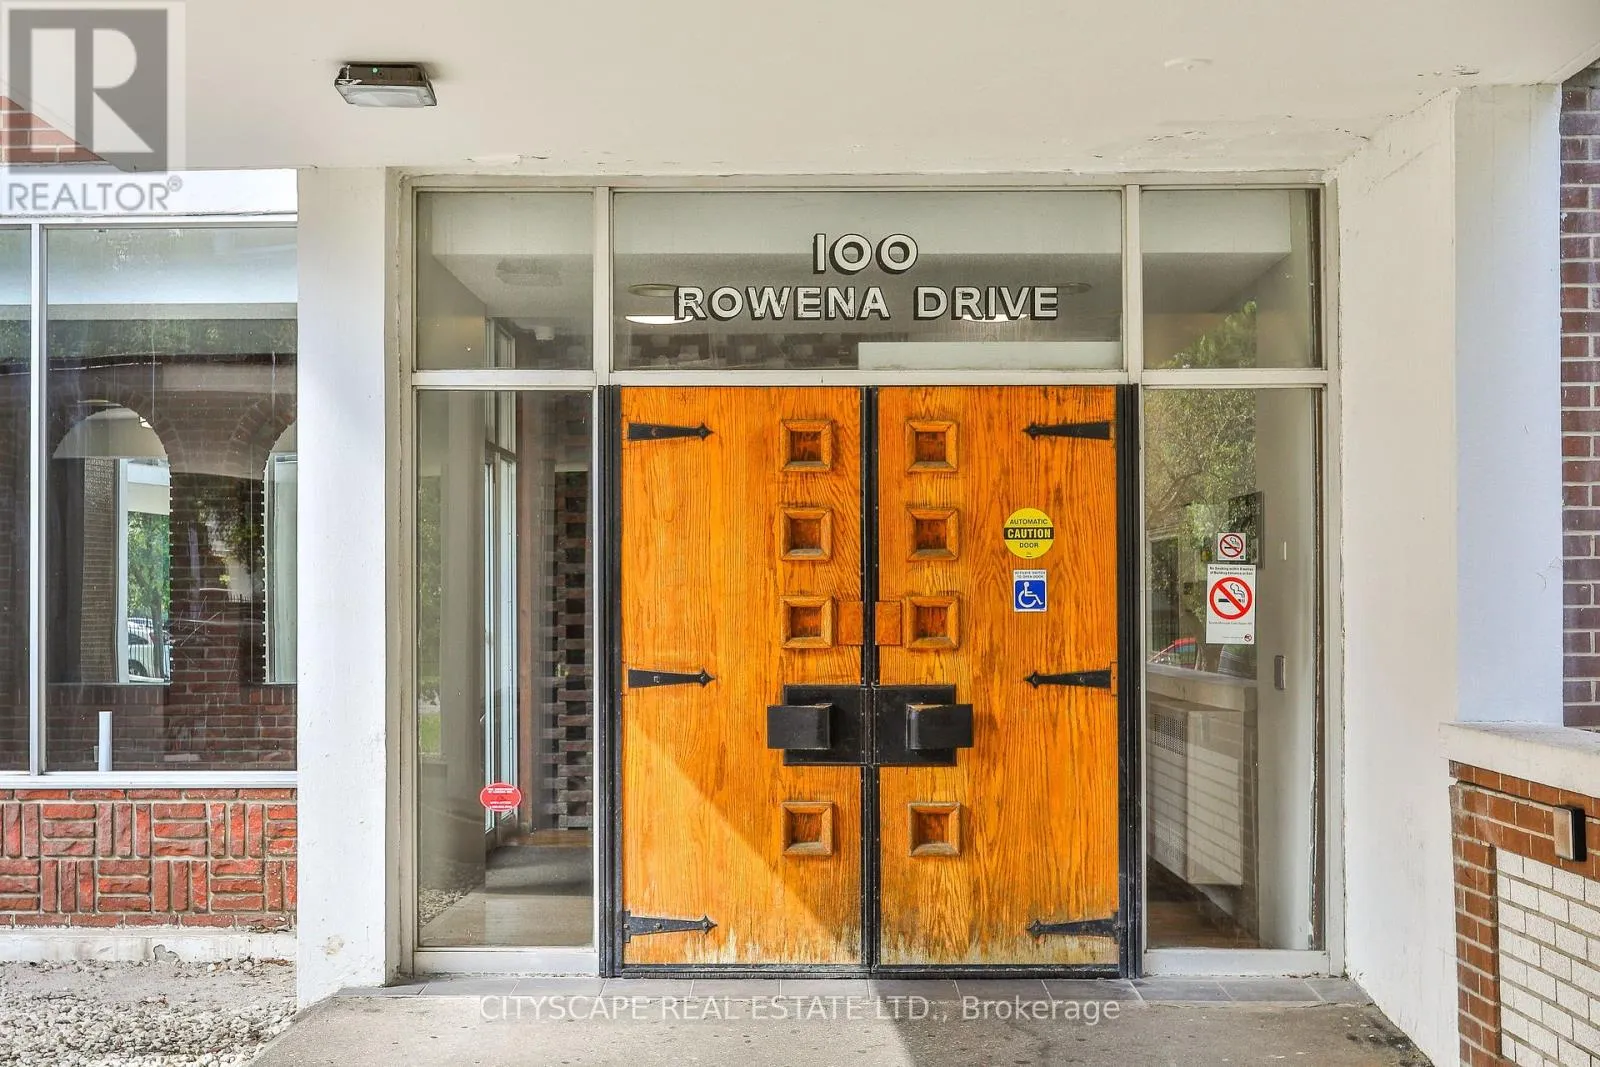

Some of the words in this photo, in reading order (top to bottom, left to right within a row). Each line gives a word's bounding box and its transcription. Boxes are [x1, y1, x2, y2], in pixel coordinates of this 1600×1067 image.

[813, 233, 919, 275] 100
[674, 286, 891, 321] ROWENA
[913, 286, 1059, 321] DRIVE
[1007, 528, 1051, 539] CAUTION
